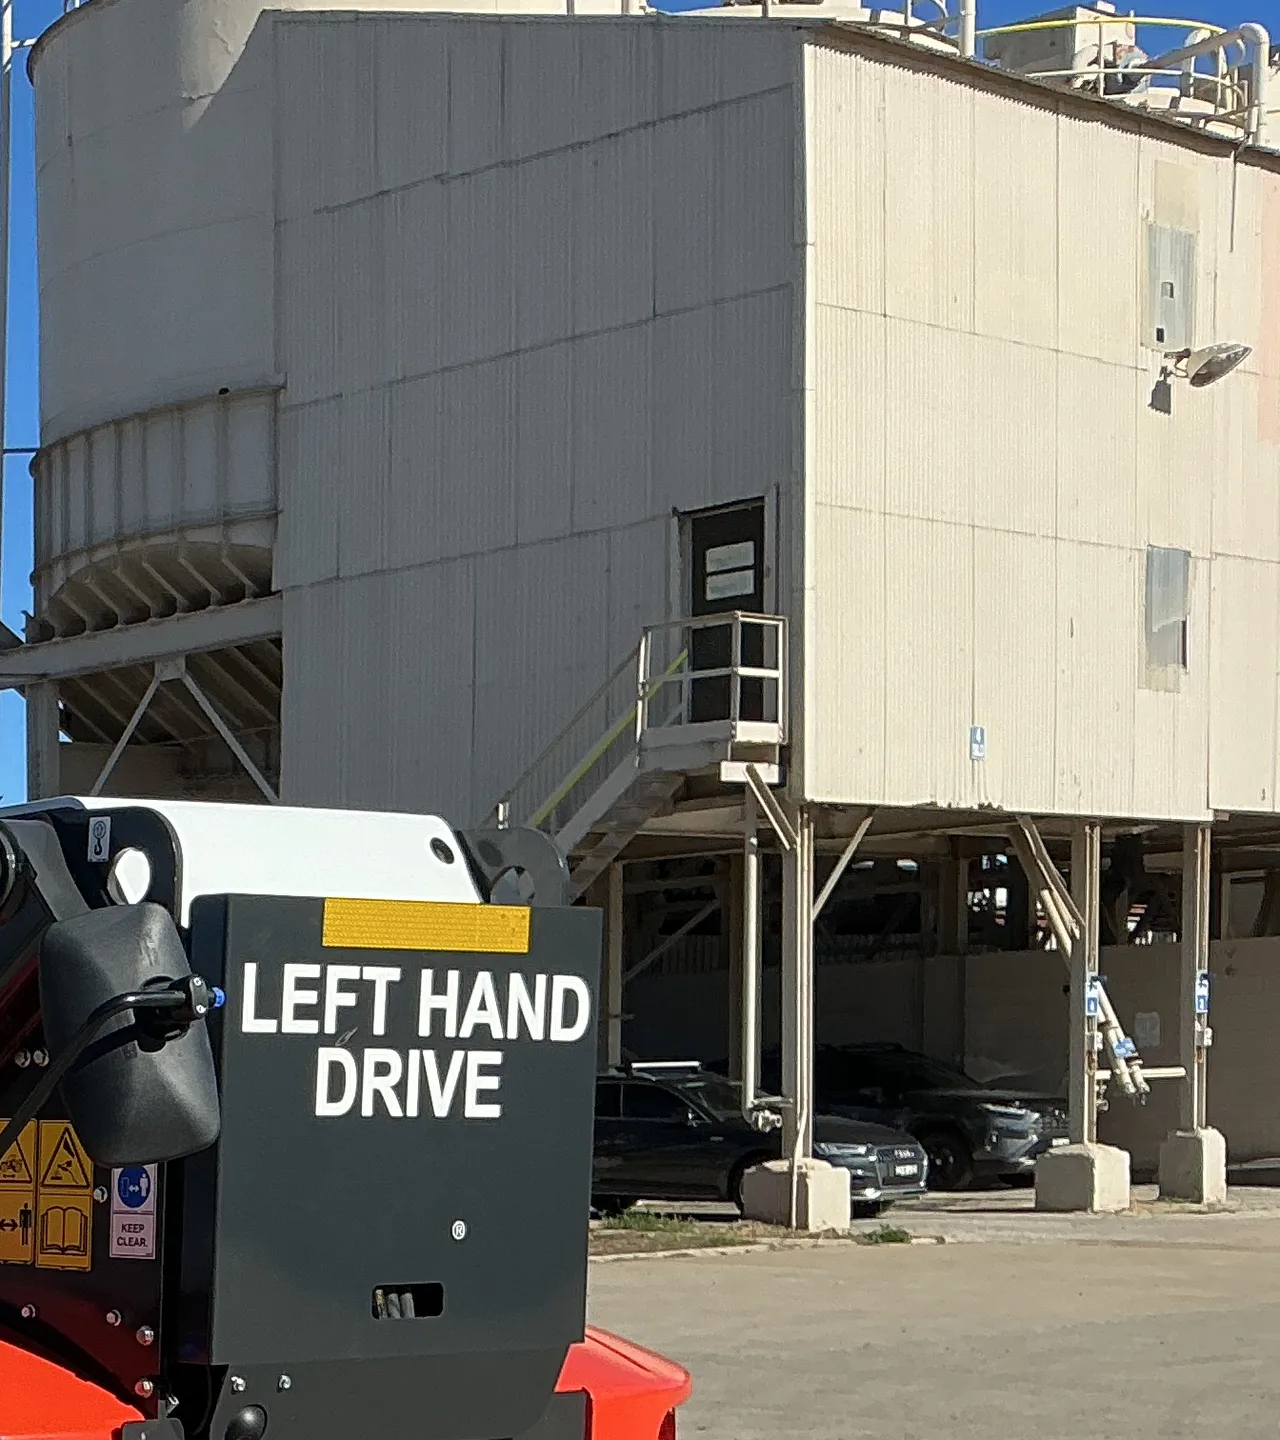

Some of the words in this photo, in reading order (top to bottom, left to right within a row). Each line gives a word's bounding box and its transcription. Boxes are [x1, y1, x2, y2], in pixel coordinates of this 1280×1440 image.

[241, 962, 401, 1036] LEFT
[418, 968, 590, 1042] HAND
[315, 1046, 503, 1118] DRIVE
[121, 1223, 145, 1233] KEEP
